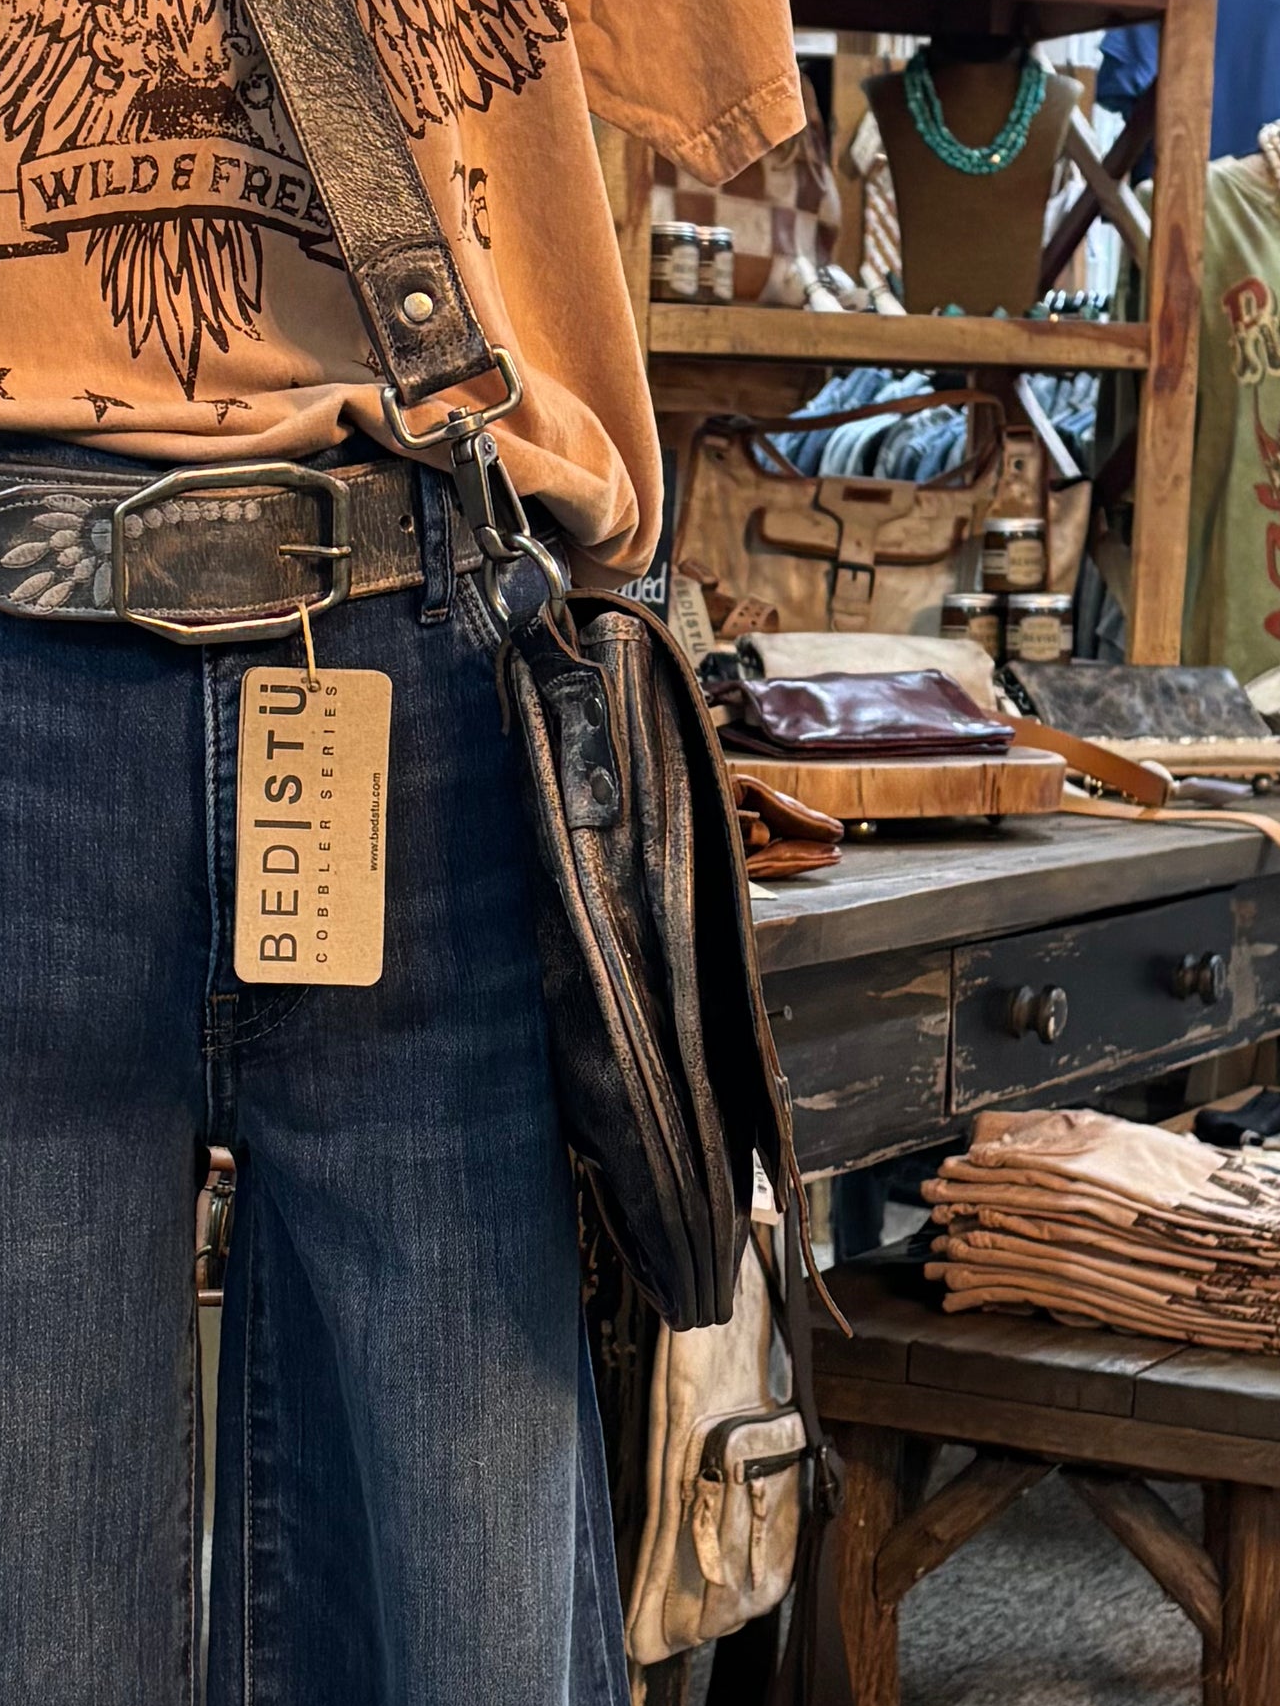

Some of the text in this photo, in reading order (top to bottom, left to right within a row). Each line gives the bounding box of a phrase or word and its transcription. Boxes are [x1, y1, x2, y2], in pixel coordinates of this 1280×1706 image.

[29, 154, 159, 212] WILD
[316, 685, 338, 964] COBBLER SERIES
[369, 771, 381, 873] www.bedstu.com
